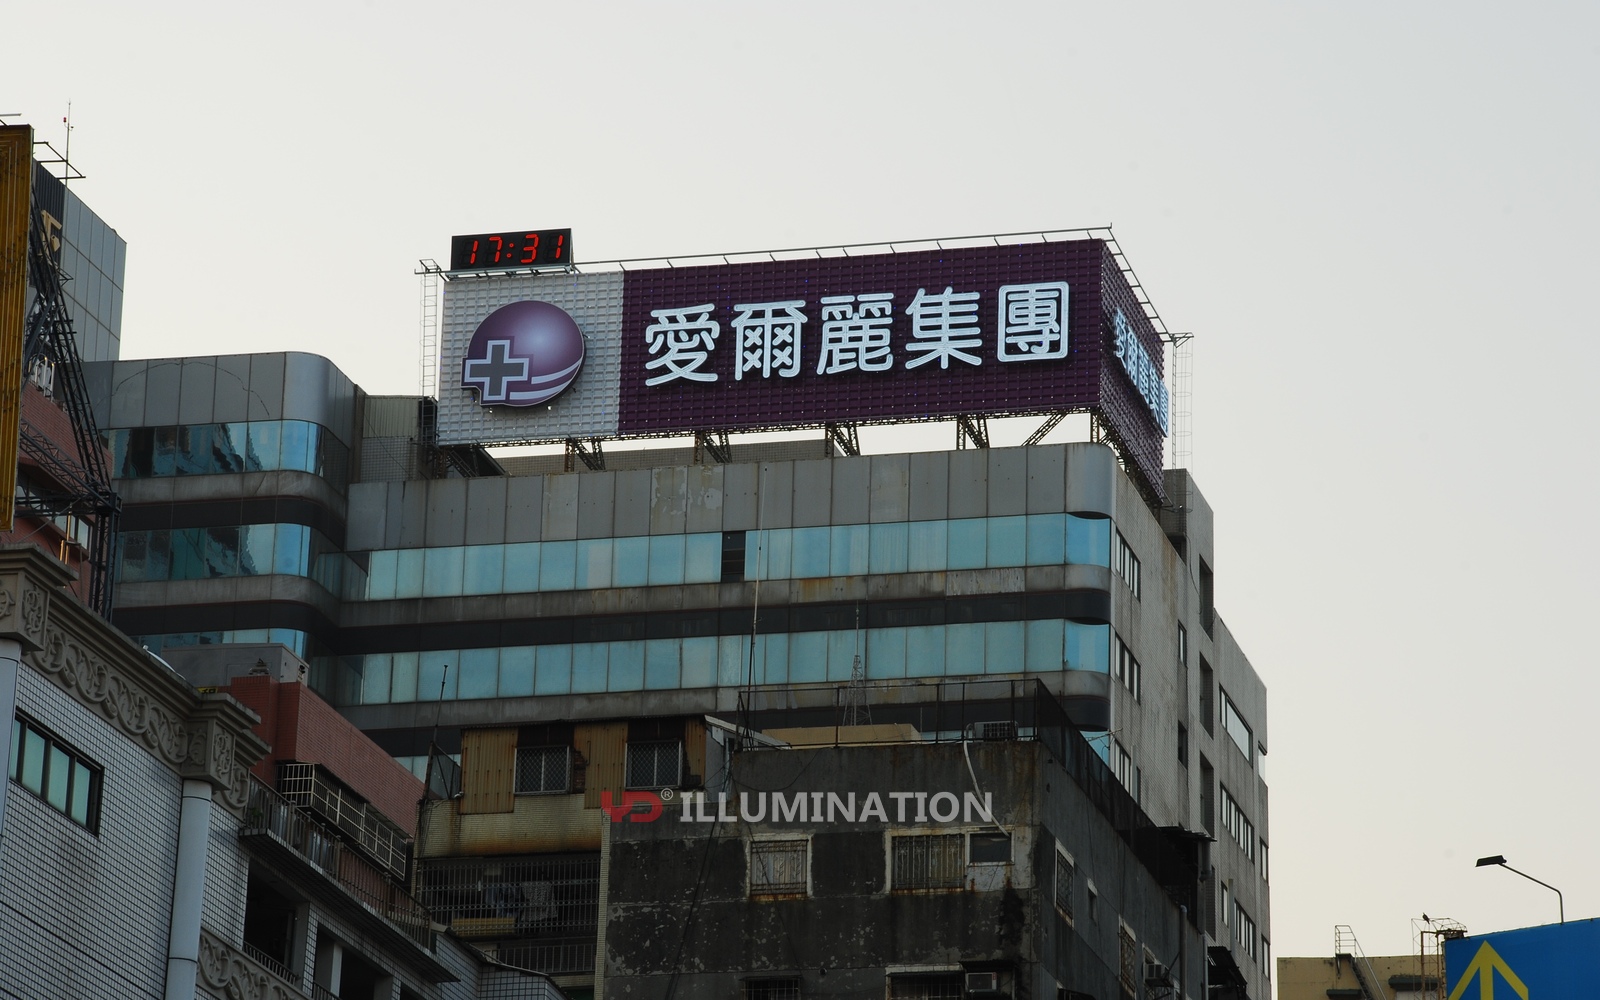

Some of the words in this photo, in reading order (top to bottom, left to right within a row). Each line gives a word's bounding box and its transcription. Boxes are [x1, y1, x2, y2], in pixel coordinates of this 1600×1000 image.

[468, 234, 563, 264] 17:31
[645, 281, 1069, 386] 愛爾麗集團
